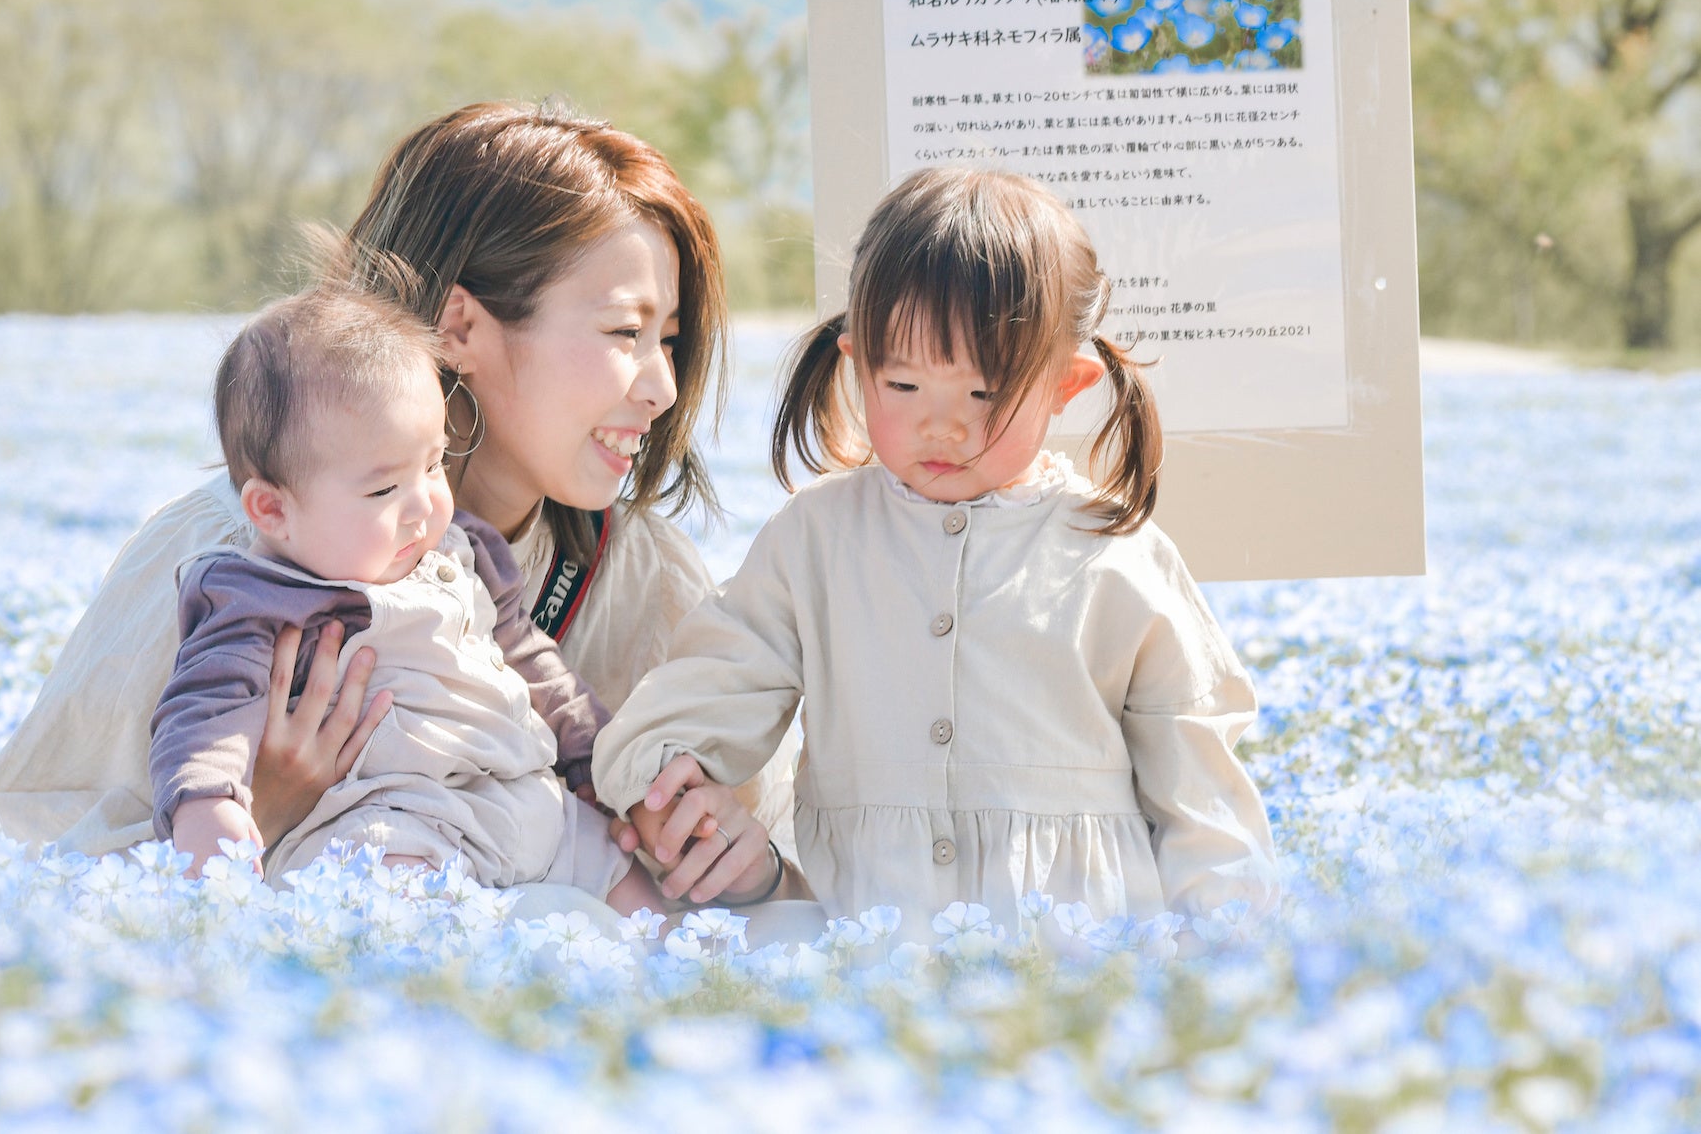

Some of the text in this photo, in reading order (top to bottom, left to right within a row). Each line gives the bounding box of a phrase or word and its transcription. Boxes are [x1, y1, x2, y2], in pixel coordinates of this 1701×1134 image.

[910, 26, 1082, 48] ムラサキ科ネモフィラ属
[1170, 301, 1217, 314] 花夢の里
[533, 561, 579, 632] Cano
